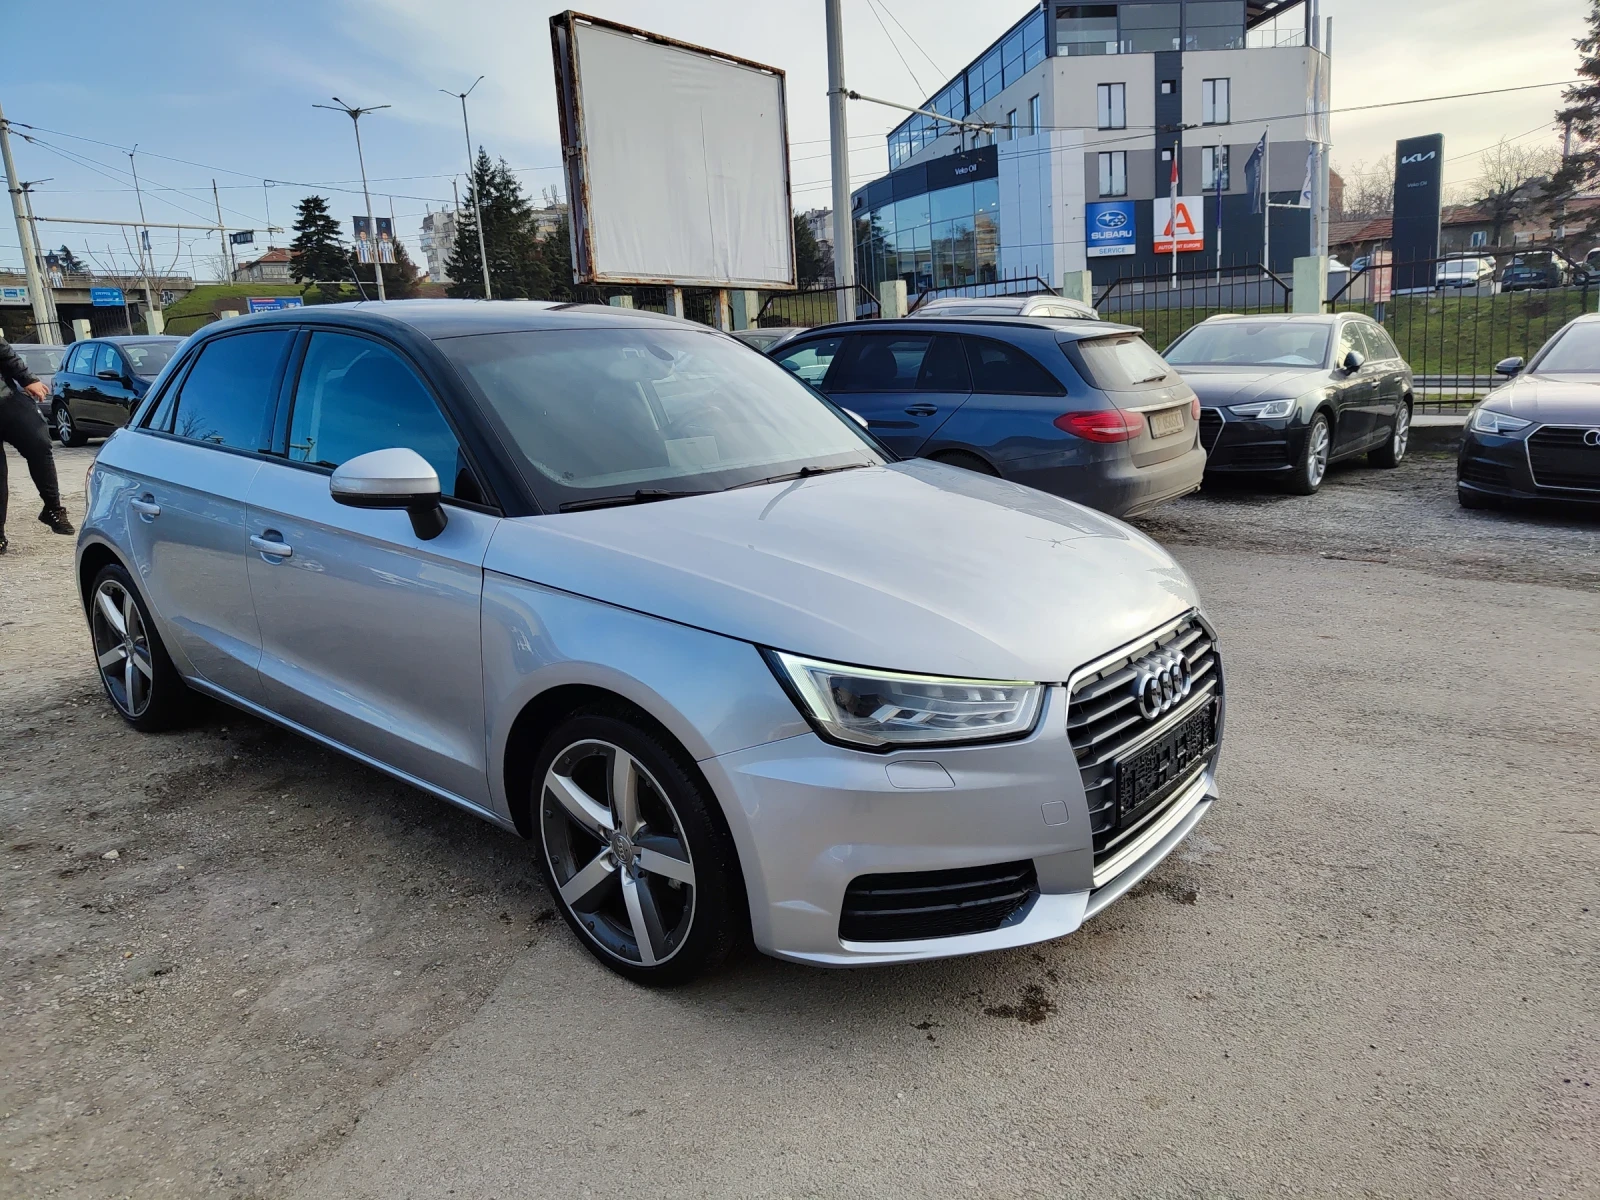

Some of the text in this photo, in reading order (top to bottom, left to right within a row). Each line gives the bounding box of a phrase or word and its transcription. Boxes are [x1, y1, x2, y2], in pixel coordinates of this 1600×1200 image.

[955, 164, 977, 175] Veko Oil
[1164, 203, 1195, 236] A
[1091, 230, 1132, 239] SUBARU
[1098, 246, 1127, 255] SERVICE
